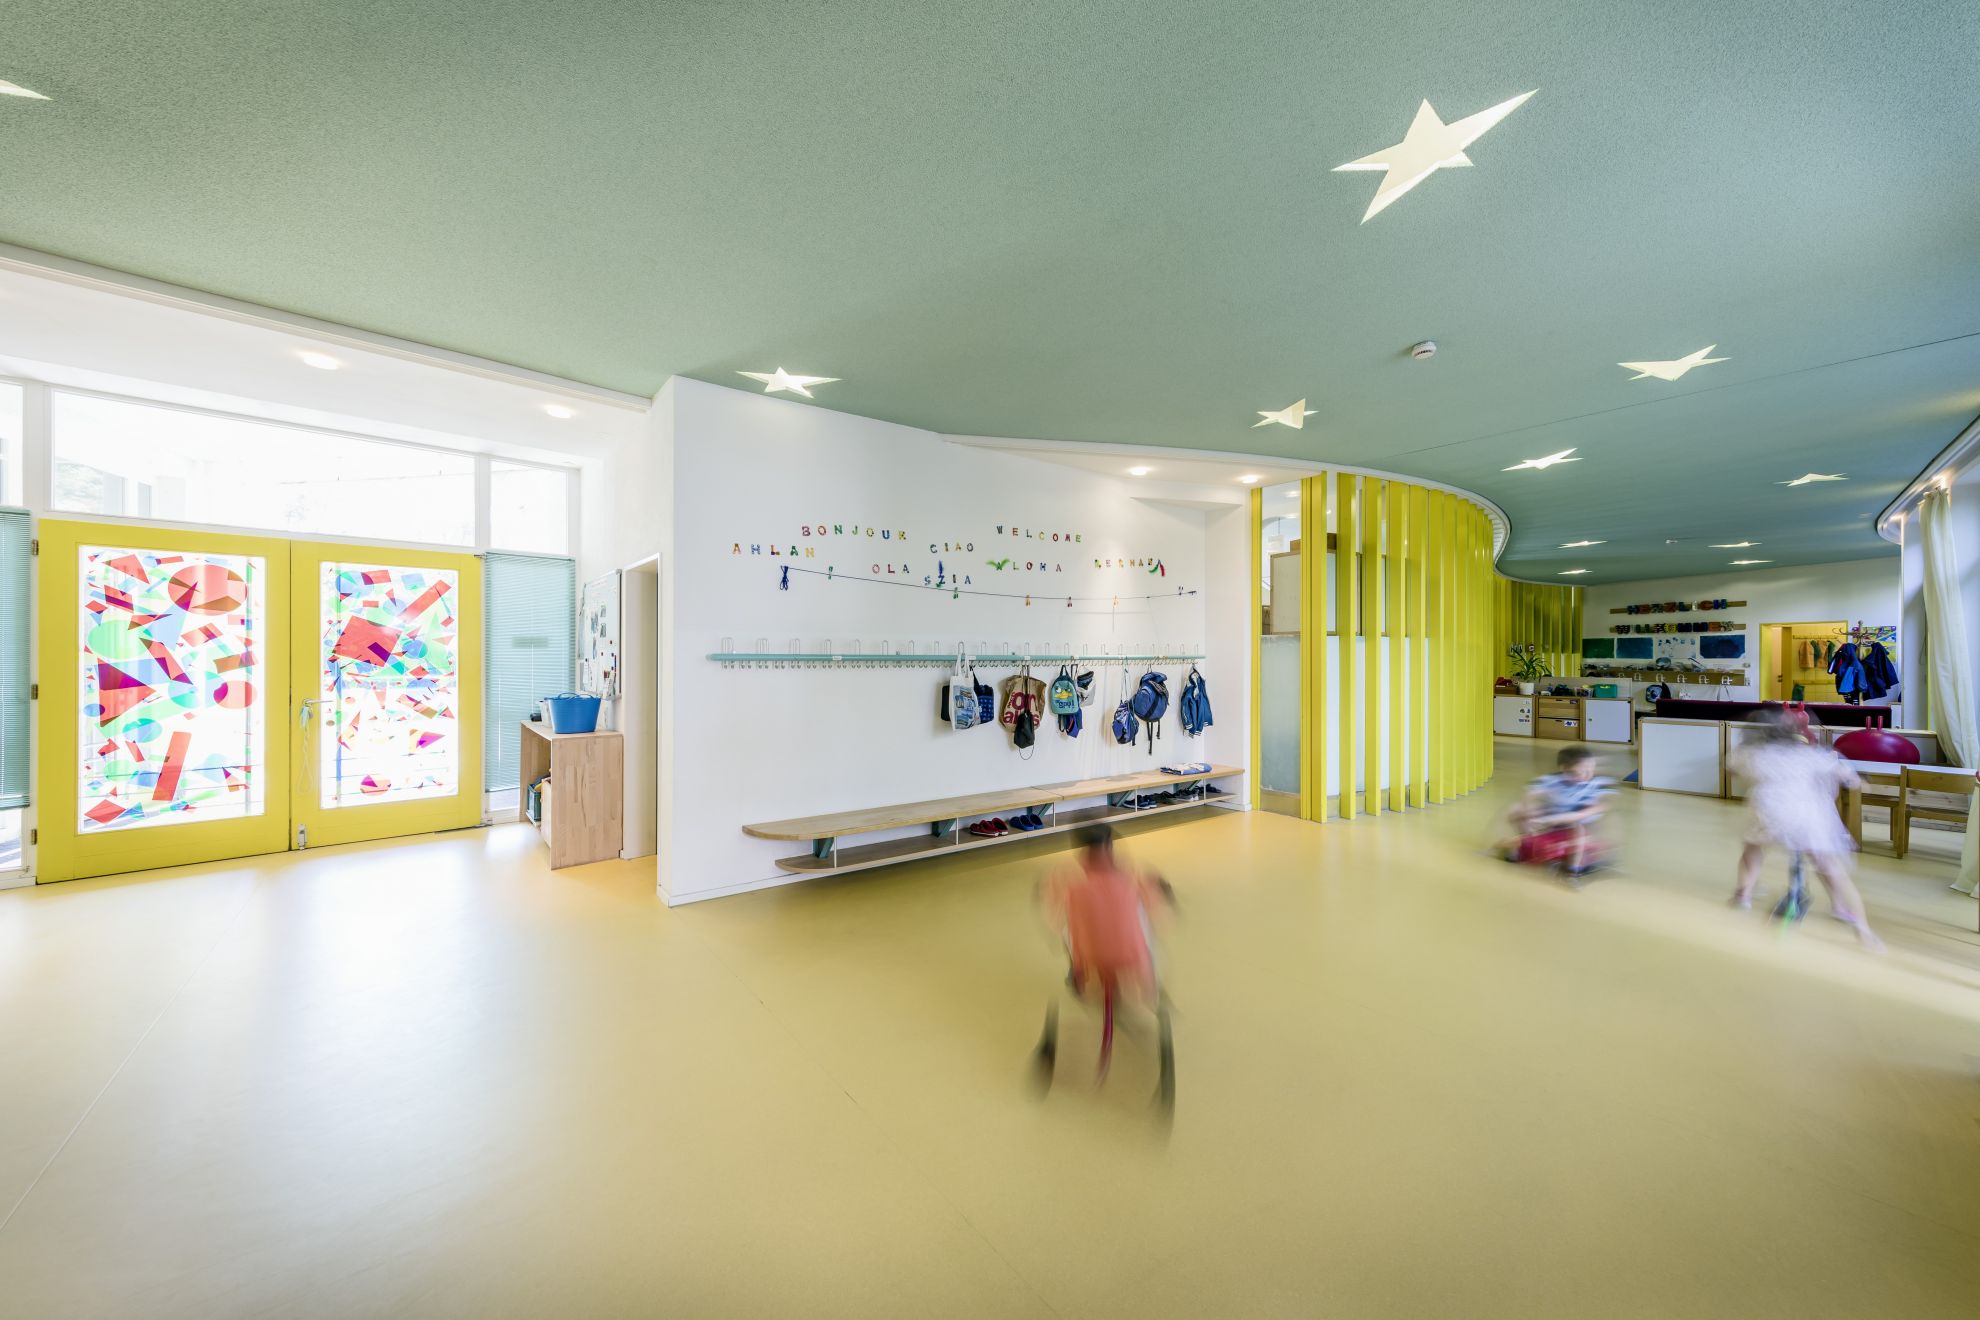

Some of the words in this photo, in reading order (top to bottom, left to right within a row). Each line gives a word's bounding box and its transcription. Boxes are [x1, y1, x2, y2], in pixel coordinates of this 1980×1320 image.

[802, 525, 906, 540] BONJOUR
[996, 526, 1082, 543] WELCOME
[732, 543, 815, 558] AHLAN
[929, 542, 974, 554] CIAO
[871, 563, 910, 574] OLA
[996, 561, 1062, 573] ALOHA
[924, 574, 972, 586] SZIA
[1627, 598, 1728, 615] HERZLICH
